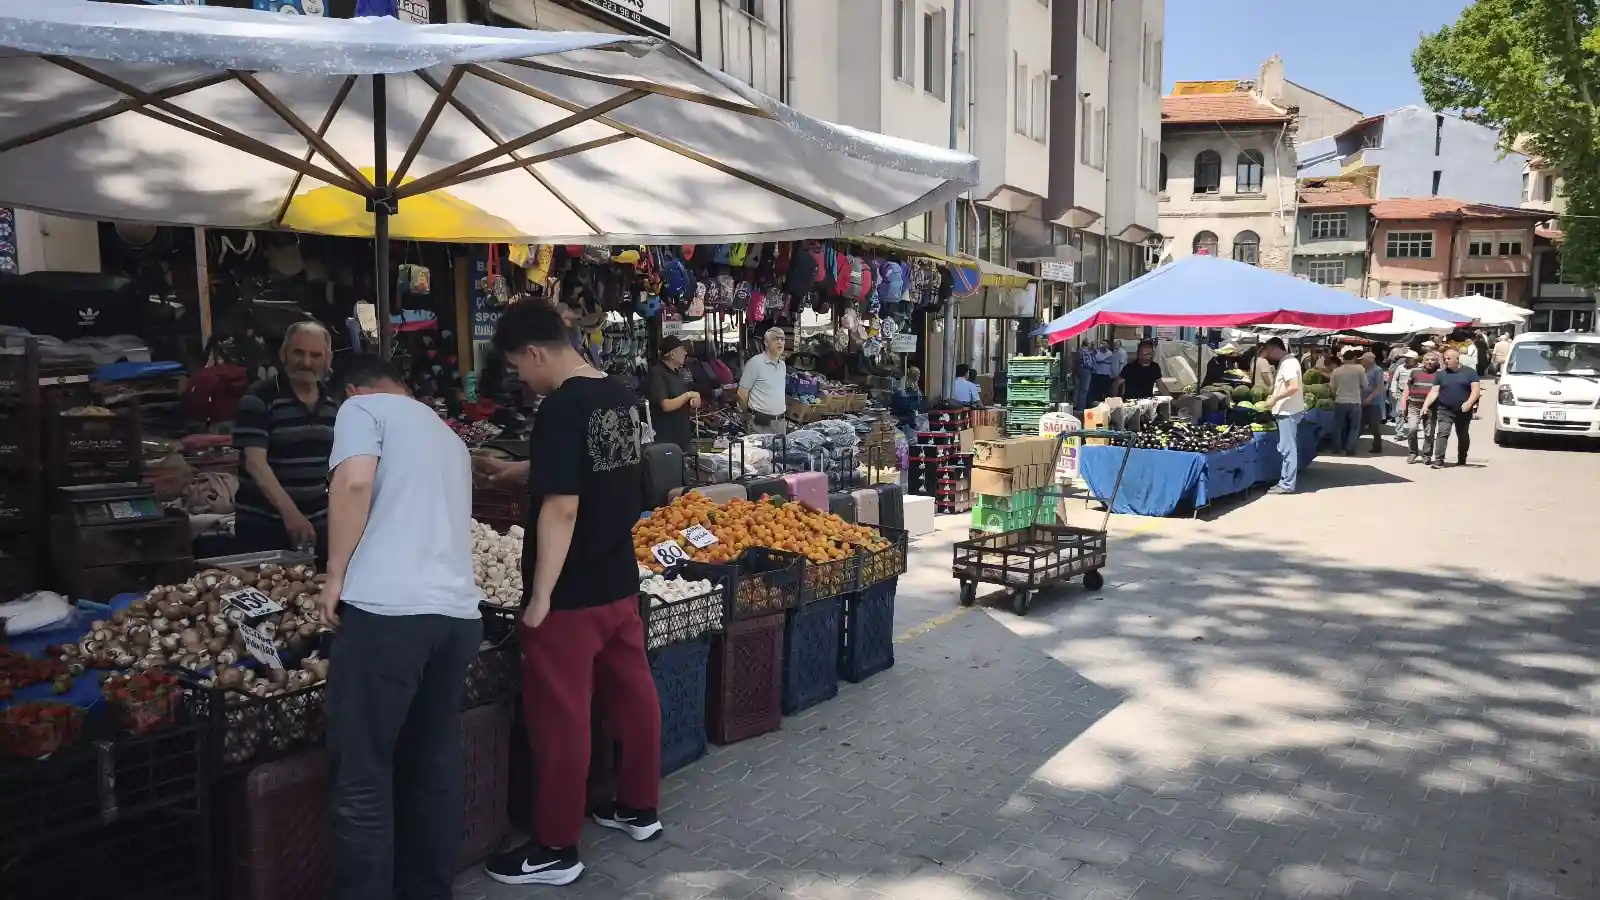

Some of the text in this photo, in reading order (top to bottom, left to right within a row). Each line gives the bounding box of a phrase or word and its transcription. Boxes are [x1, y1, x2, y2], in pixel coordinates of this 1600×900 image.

[396, 0, 428, 19] lam
[631, 12, 641, 23] 49
[657, 545, 683, 565] 80
[229, 592, 268, 611] 150
